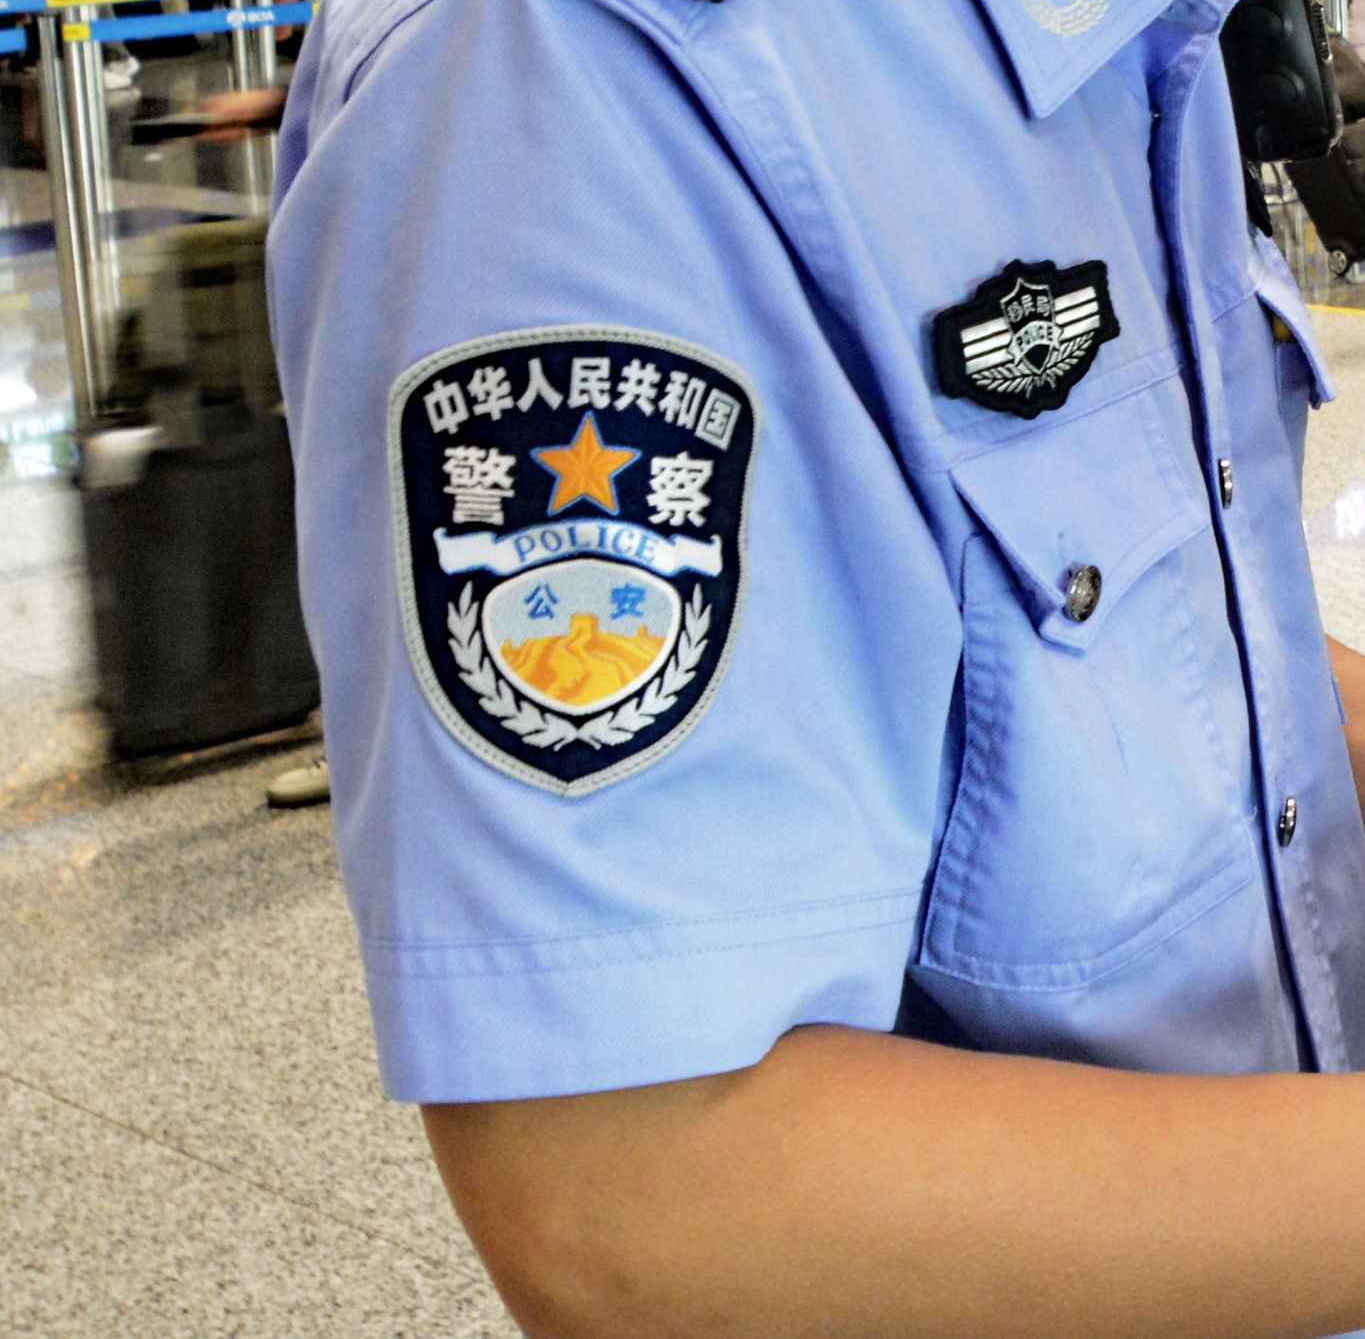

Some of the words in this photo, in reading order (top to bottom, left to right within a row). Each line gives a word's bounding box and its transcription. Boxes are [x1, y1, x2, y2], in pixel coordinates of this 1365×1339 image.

[423, 357, 742, 452] 中华人民共和国
[513, 524, 660, 564] POLICE
